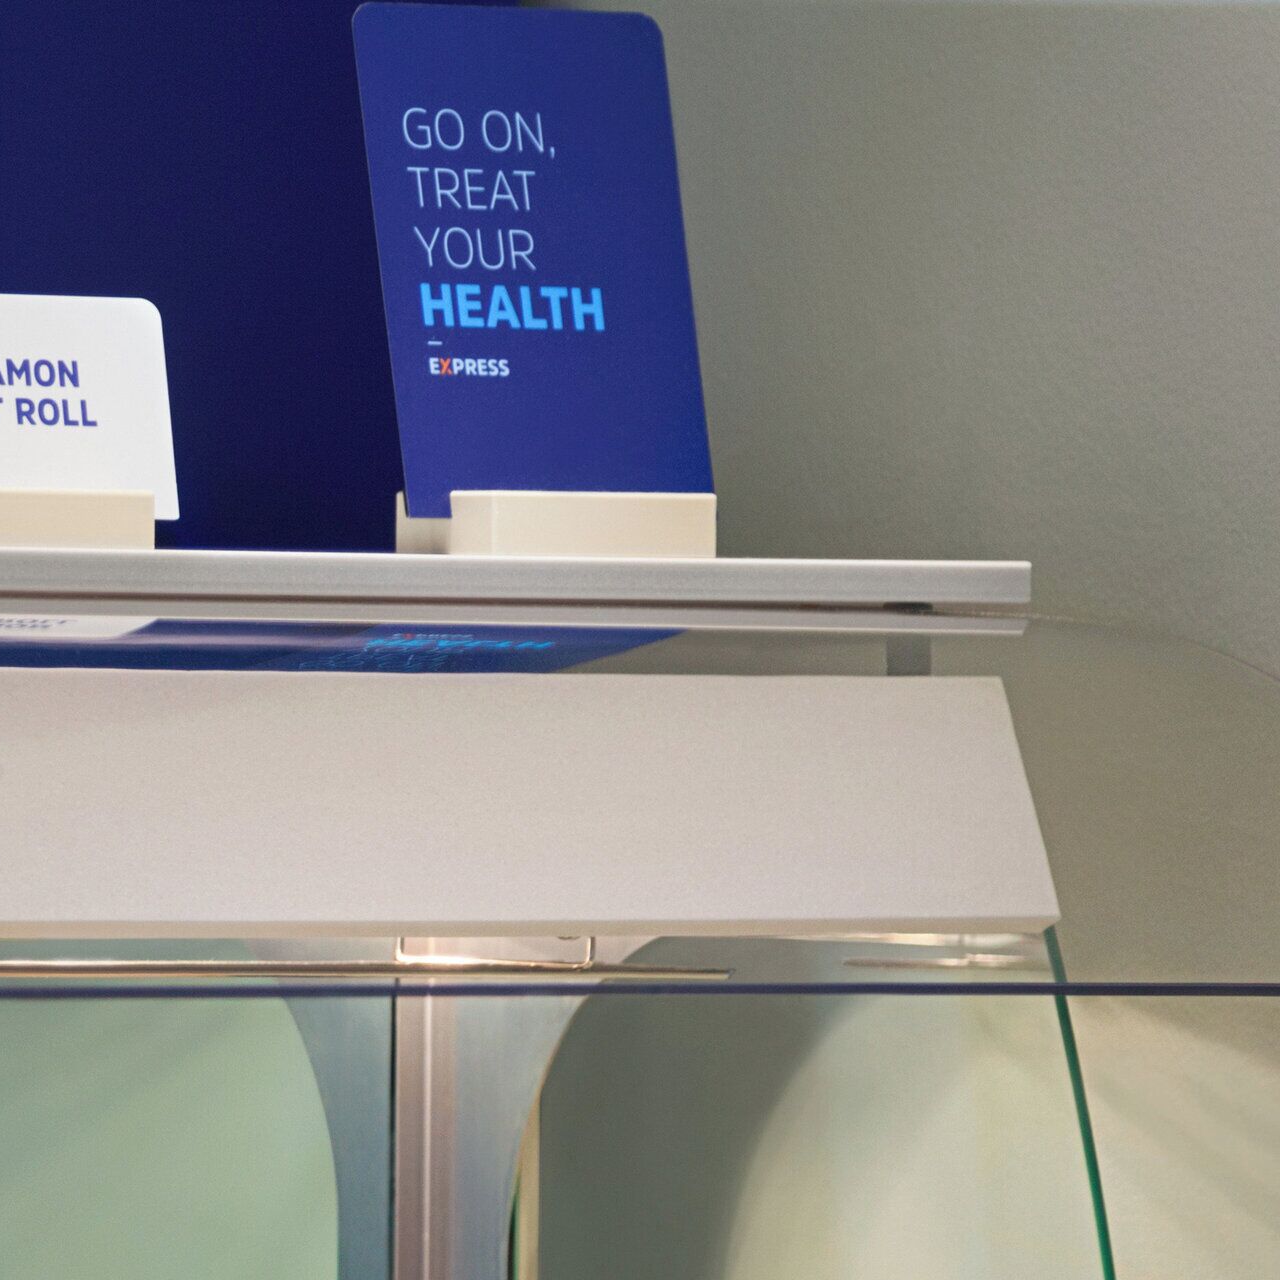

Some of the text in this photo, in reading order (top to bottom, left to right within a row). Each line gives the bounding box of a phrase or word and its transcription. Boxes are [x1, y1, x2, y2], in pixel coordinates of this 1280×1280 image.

[402, 107, 556, 159] GO ON,
[406, 166, 536, 211] TREAT
[413, 226, 537, 272] YOUR
[419, 282, 605, 332] HEALTH
[429, 357, 510, 377] EXPRESS
[15, 398, 98, 428] ROLL
